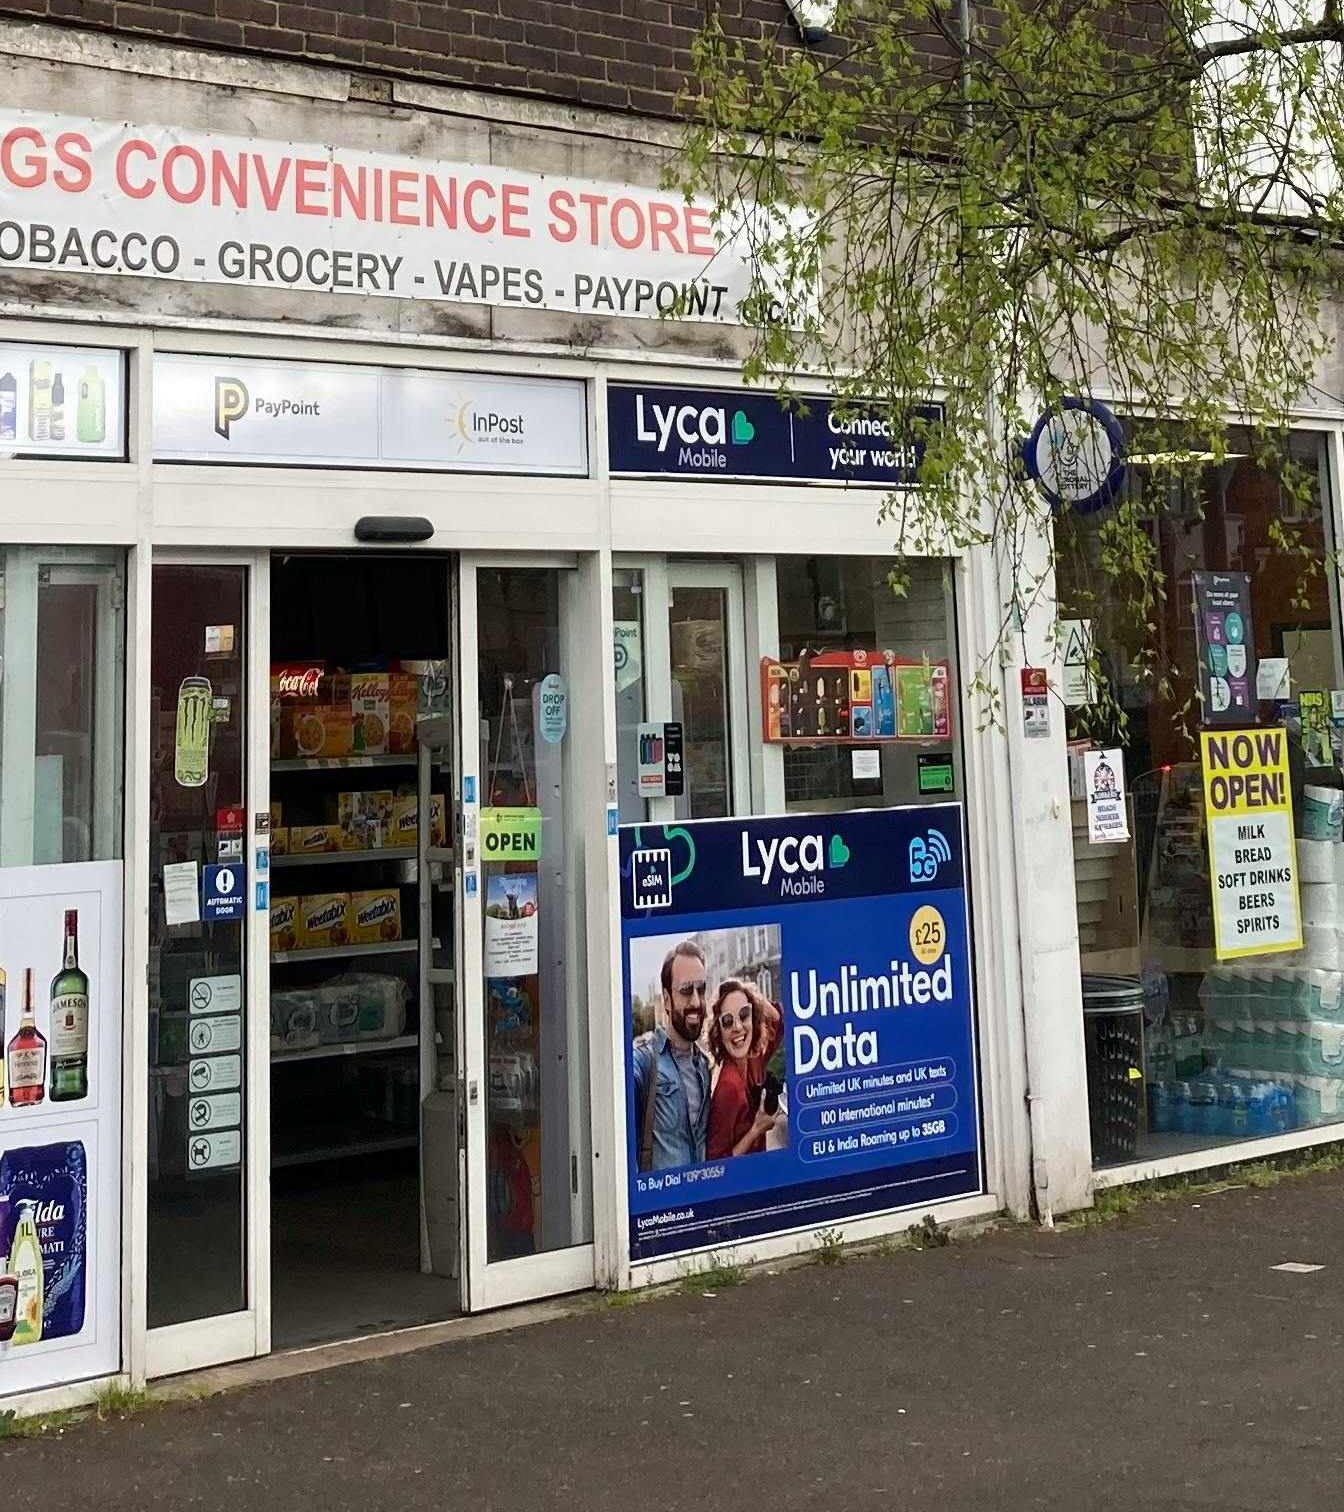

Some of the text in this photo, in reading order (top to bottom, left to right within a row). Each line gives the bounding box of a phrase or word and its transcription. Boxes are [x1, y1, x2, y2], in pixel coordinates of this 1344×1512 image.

[115, 138, 532, 239] CONVENIENCE
[547, 188, 717, 257] STORE
[217, 241, 405, 290] GROCERY
[434, 260, 544, 304] VAPES
[573, 273, 729, 319] PAYPOINT
[255, 398, 320, 418] PayPoint
[473, 410, 524, 434] InPost
[636, 394, 726, 452] Lyca
[678, 446, 727, 469] Mobile
[828, 446, 867, 470] your
[613, 627, 638, 639] Point
[542, 693, 565, 705] DROP
[545, 705, 560, 716] OFF
[1208, 734, 1282, 770] NOW
[1210, 772, 1287, 810] OPEN!
[485, 831, 536, 852] OPEN
[1237, 824, 1265, 840] MILK
[742, 831, 824, 884] Lyca
[1234, 846, 1272, 864] BREAD
[642, 874, 663, 887] eSIM
[780, 877, 825, 897] Mobile
[1218, 868, 1291, 889] SOFT DRINKS
[207, 896, 244, 906] AUTOMATIC
[216, 905, 235, 915] DOOR
[357, 897, 396, 923] Weetabix
[1239, 892, 1275, 910] BEERS
[307, 901, 347, 930] Weetabix
[1237, 914, 1280, 934] SPIRITS
[915, 921, 941, 945] £25
[791, 953, 953, 1020] Unlimited
[52, 998, 87, 1014] JAMESON
[792, 1022, 878, 1075] Data
[806, 1066, 947, 1097] Unlimited UK minutes and UK texts
[821, 1108, 836, 1125] 100
[838, 1099, 895, 1123] International
[813, 1141, 826, 1155] EU
[828, 1140, 835, 1152] &
[837, 1134, 858, 1151] India
[860, 1129, 897, 1147] Roaming
[899, 1127, 910, 1143] up
[912, 1125, 920, 1138] to
[637, 1173, 681, 1191] To Buy Dial
[20, 1221, 33, 1237] 1L
